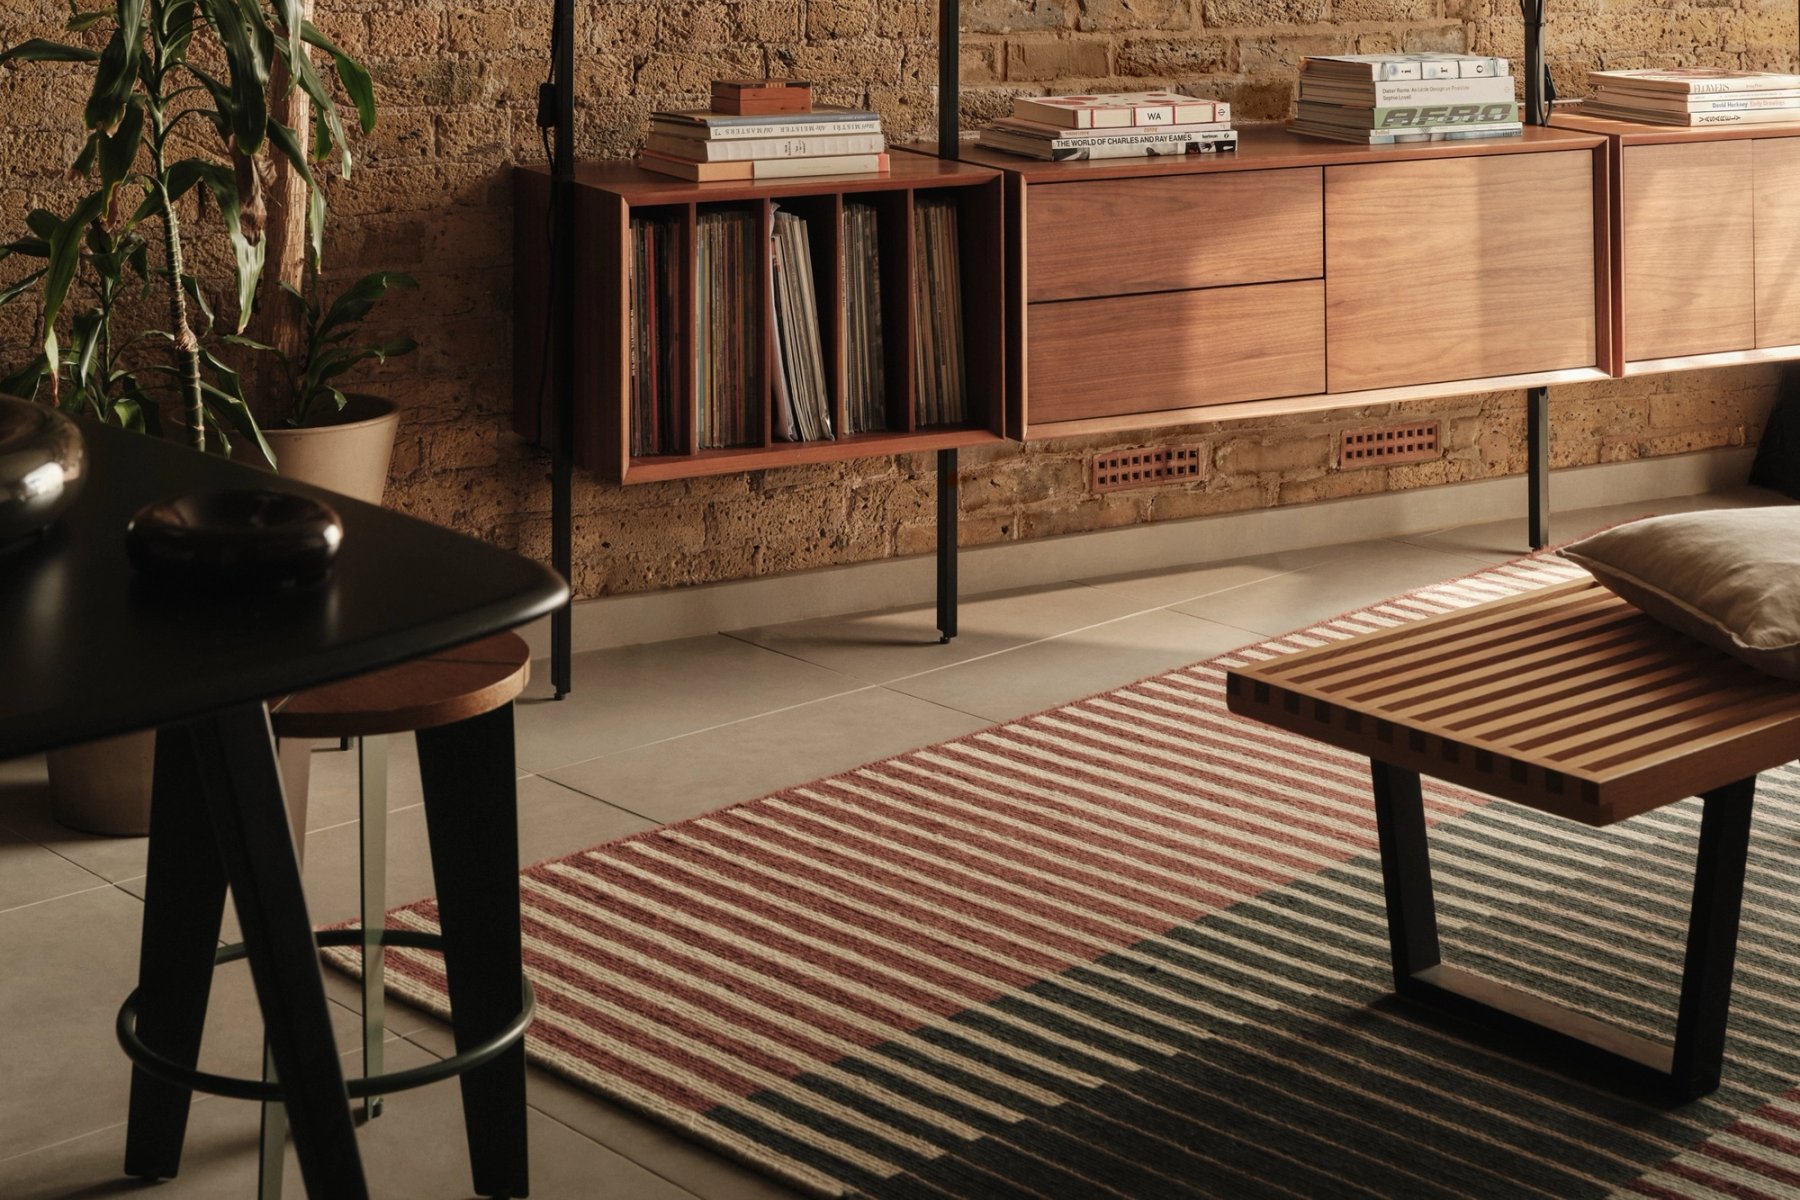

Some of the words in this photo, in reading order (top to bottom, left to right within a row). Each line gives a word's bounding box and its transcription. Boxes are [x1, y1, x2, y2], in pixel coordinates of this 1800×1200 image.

[1147, 112, 1161, 120] WA
[1381, 104, 1513, 127] AFRO
[725, 127, 763, 135] MASTERS
[779, 125, 815, 133] MEISTER
[1071, 139, 1096, 147] WORLD
[1107, 137, 1139, 145] CHARLES
